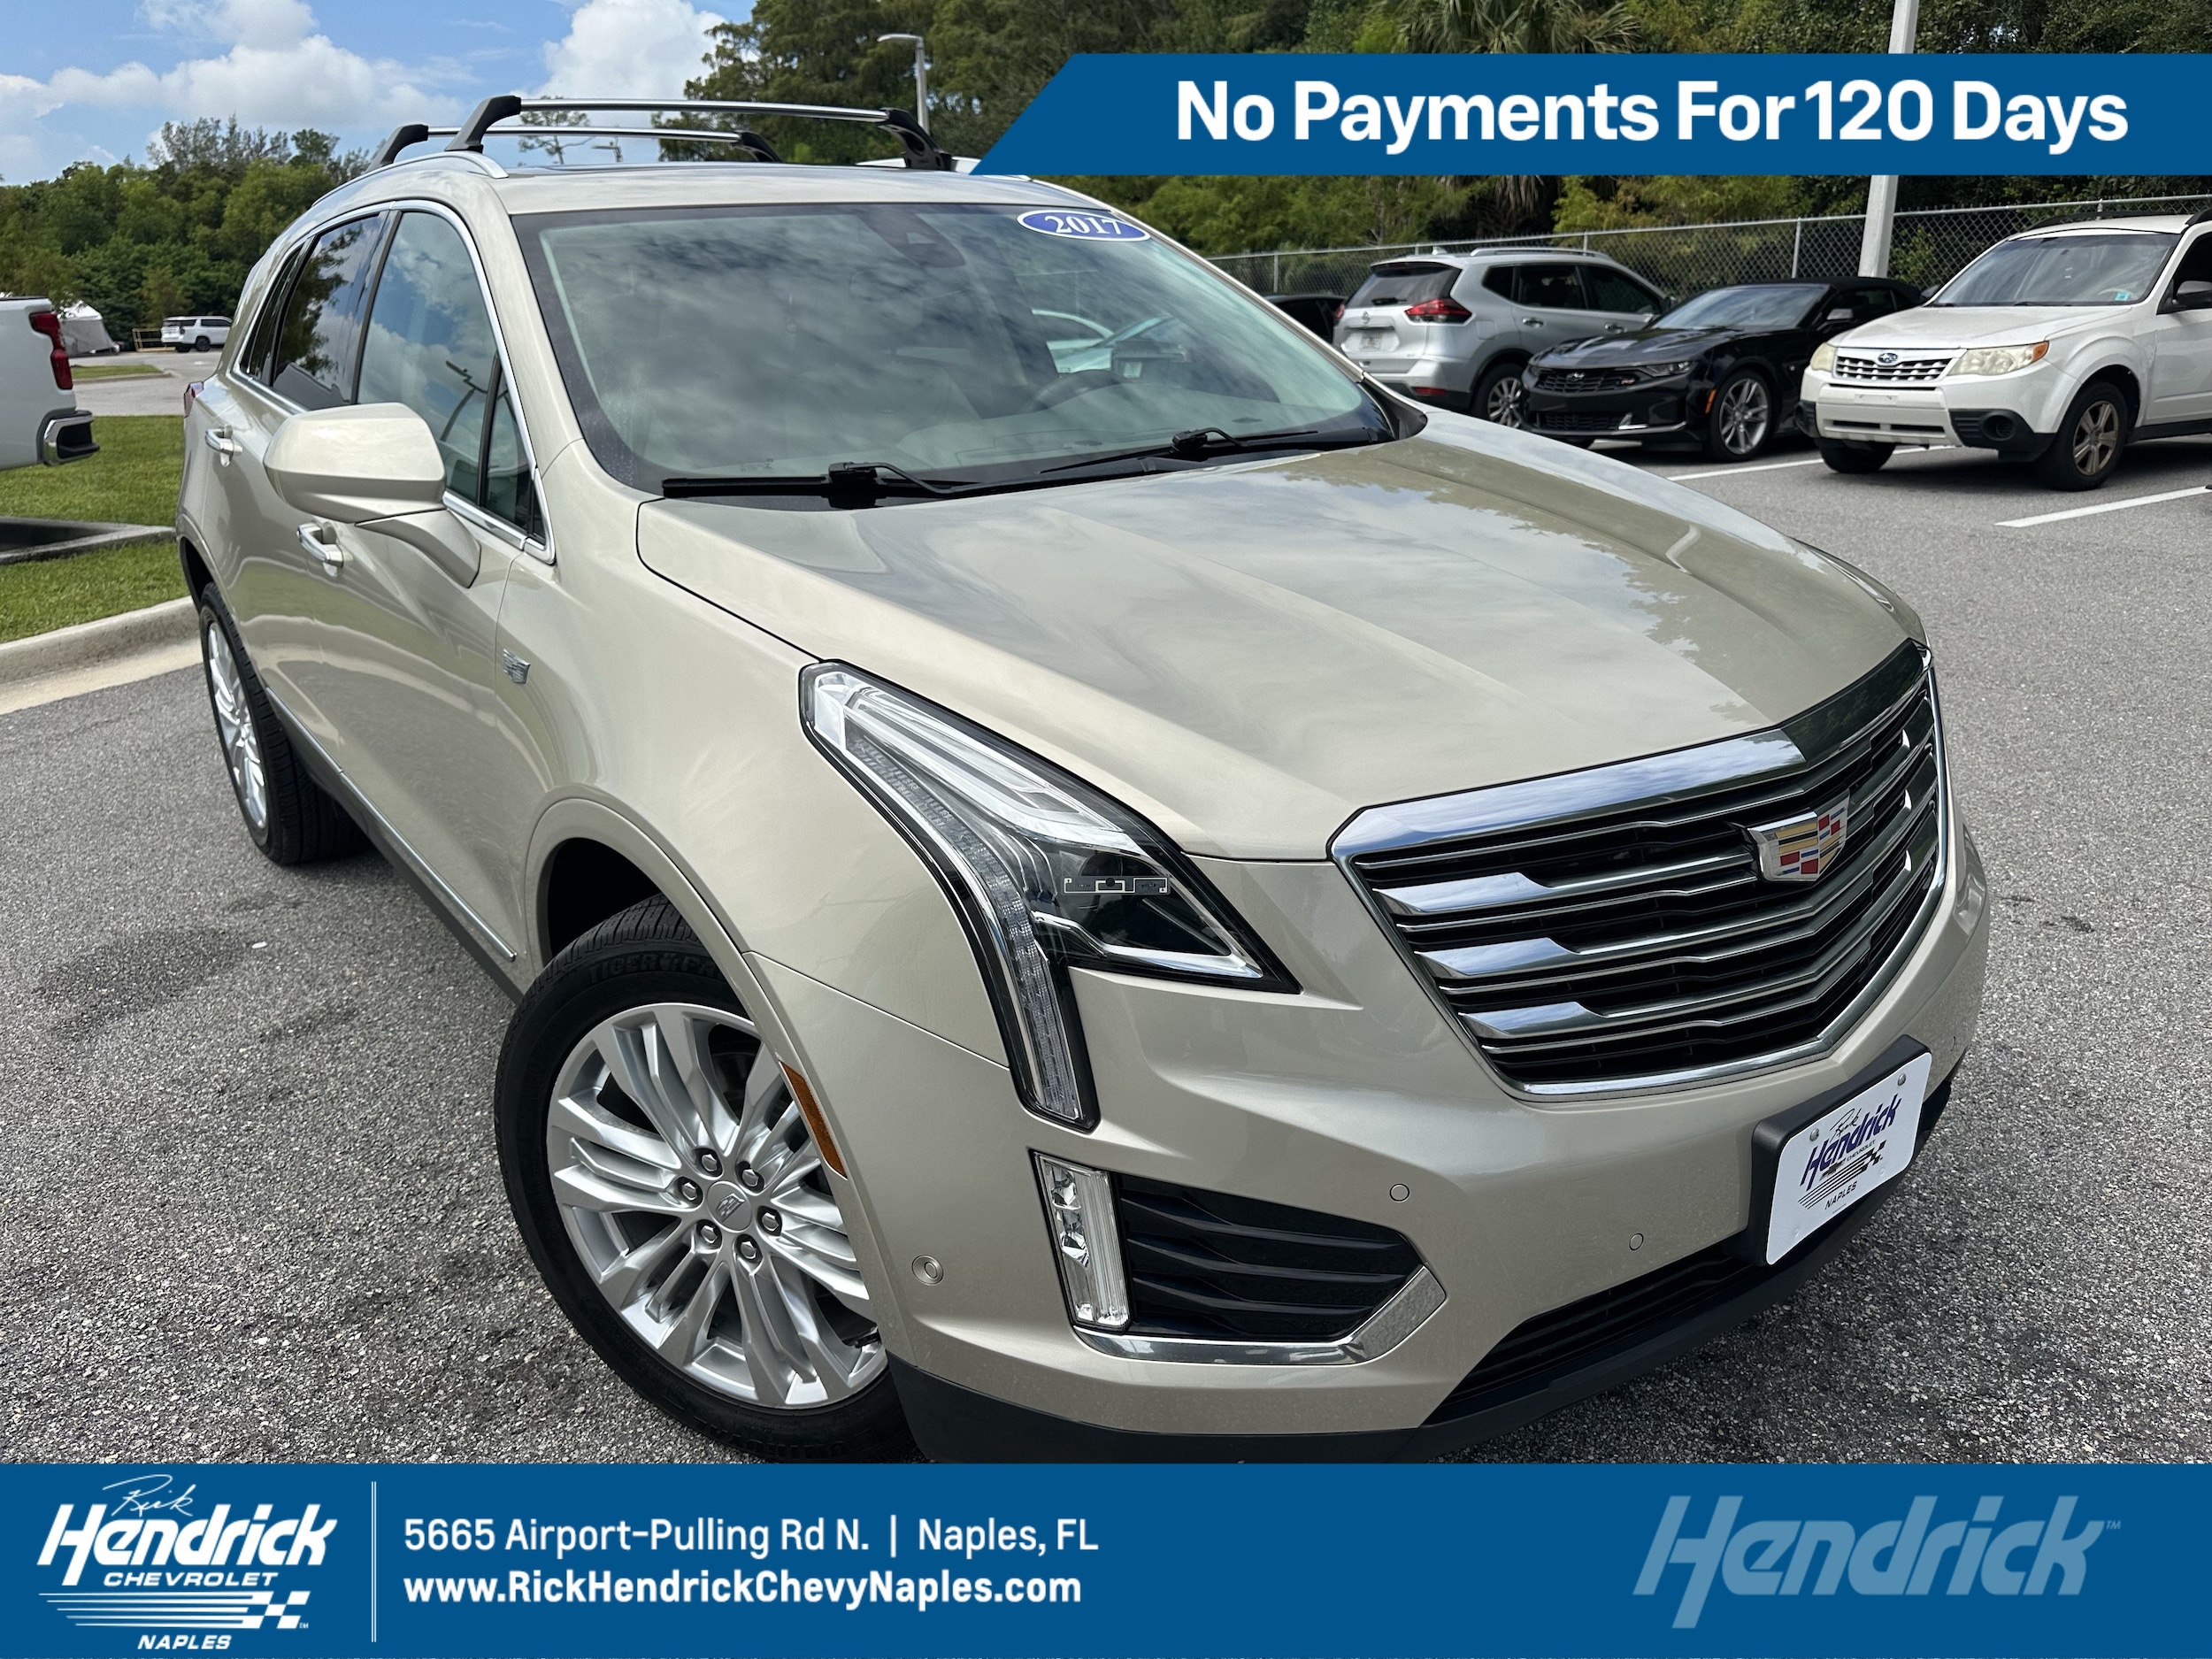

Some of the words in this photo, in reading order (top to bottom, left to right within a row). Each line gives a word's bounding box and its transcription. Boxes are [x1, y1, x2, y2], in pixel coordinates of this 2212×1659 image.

[1044, 215, 1122, 235] 2017
[588, 953, 659, 983] TIGER
[680, 955, 718, 978] PA
[1800, 1093, 1901, 1192] Hendrick
[1824, 1181, 1858, 1210] NAPLES
